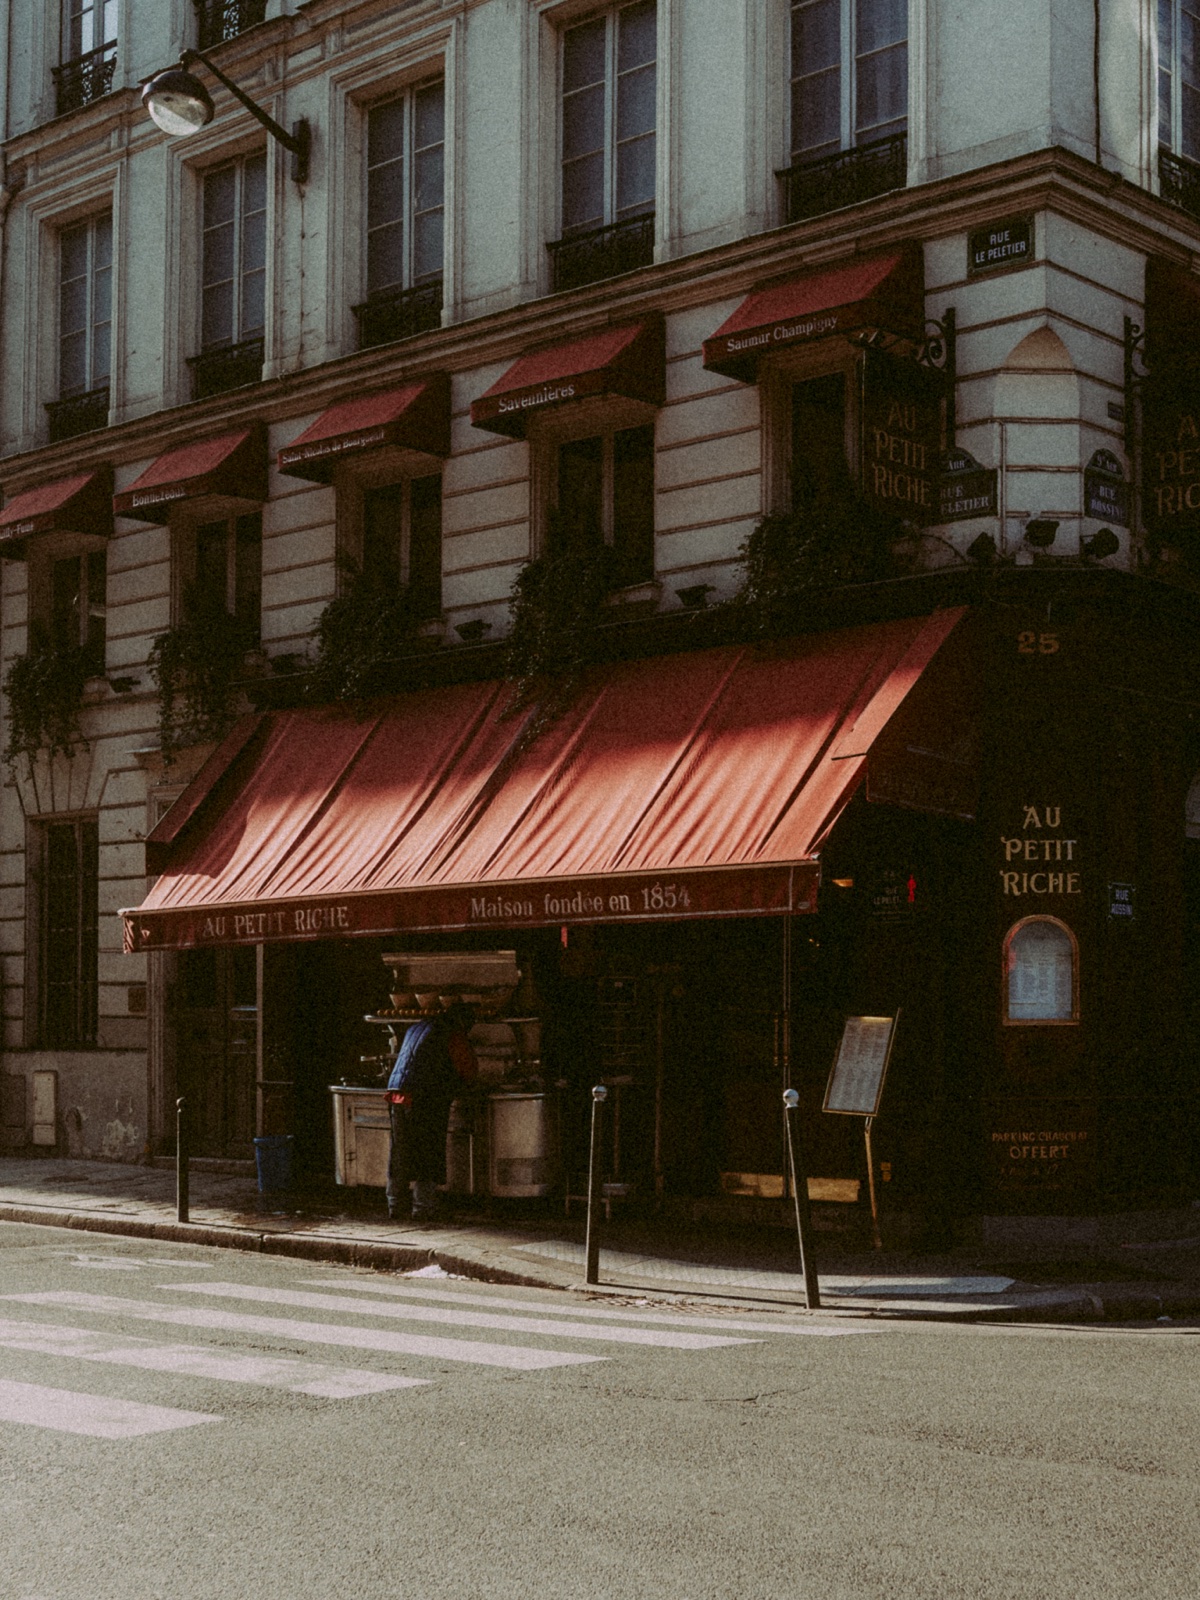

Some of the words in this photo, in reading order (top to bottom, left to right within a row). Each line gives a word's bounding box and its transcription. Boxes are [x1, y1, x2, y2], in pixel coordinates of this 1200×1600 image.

[990, 230, 1010, 245] RUE
[975, 251, 985, 263] LE
[988, 241, 1026, 261] PELETIER
[727, 333, 771, 352] Saumur
[773, 316, 838, 340] Champigny
[498, 384, 575, 413] Savennières
[888, 402, 916, 432] AU
[872, 427, 926, 470] PETIT
[872, 462, 931, 507] RICHE
[1099, 486, 1115, 501] RUE
[1017, 631, 1060, 654] 25
[1023, 805, 1061, 830] AU
[1000, 836, 1077, 861] PETIT
[999, 870, 1082, 896] RICHE
[1115, 889, 1129, 901] RUE
[471, 896, 534, 919] Maison
[543, 891, 605, 916] fondée
[608, 893, 632, 912] en
[641, 882, 692, 912] 1854
[203, 916, 226, 938] AU
[234, 911, 287, 935] PETIT
[294, 906, 350, 931] RICHE
[991, 1131, 1036, 1142] PARKING
[1009, 1145, 1069, 1160] OFFERT
